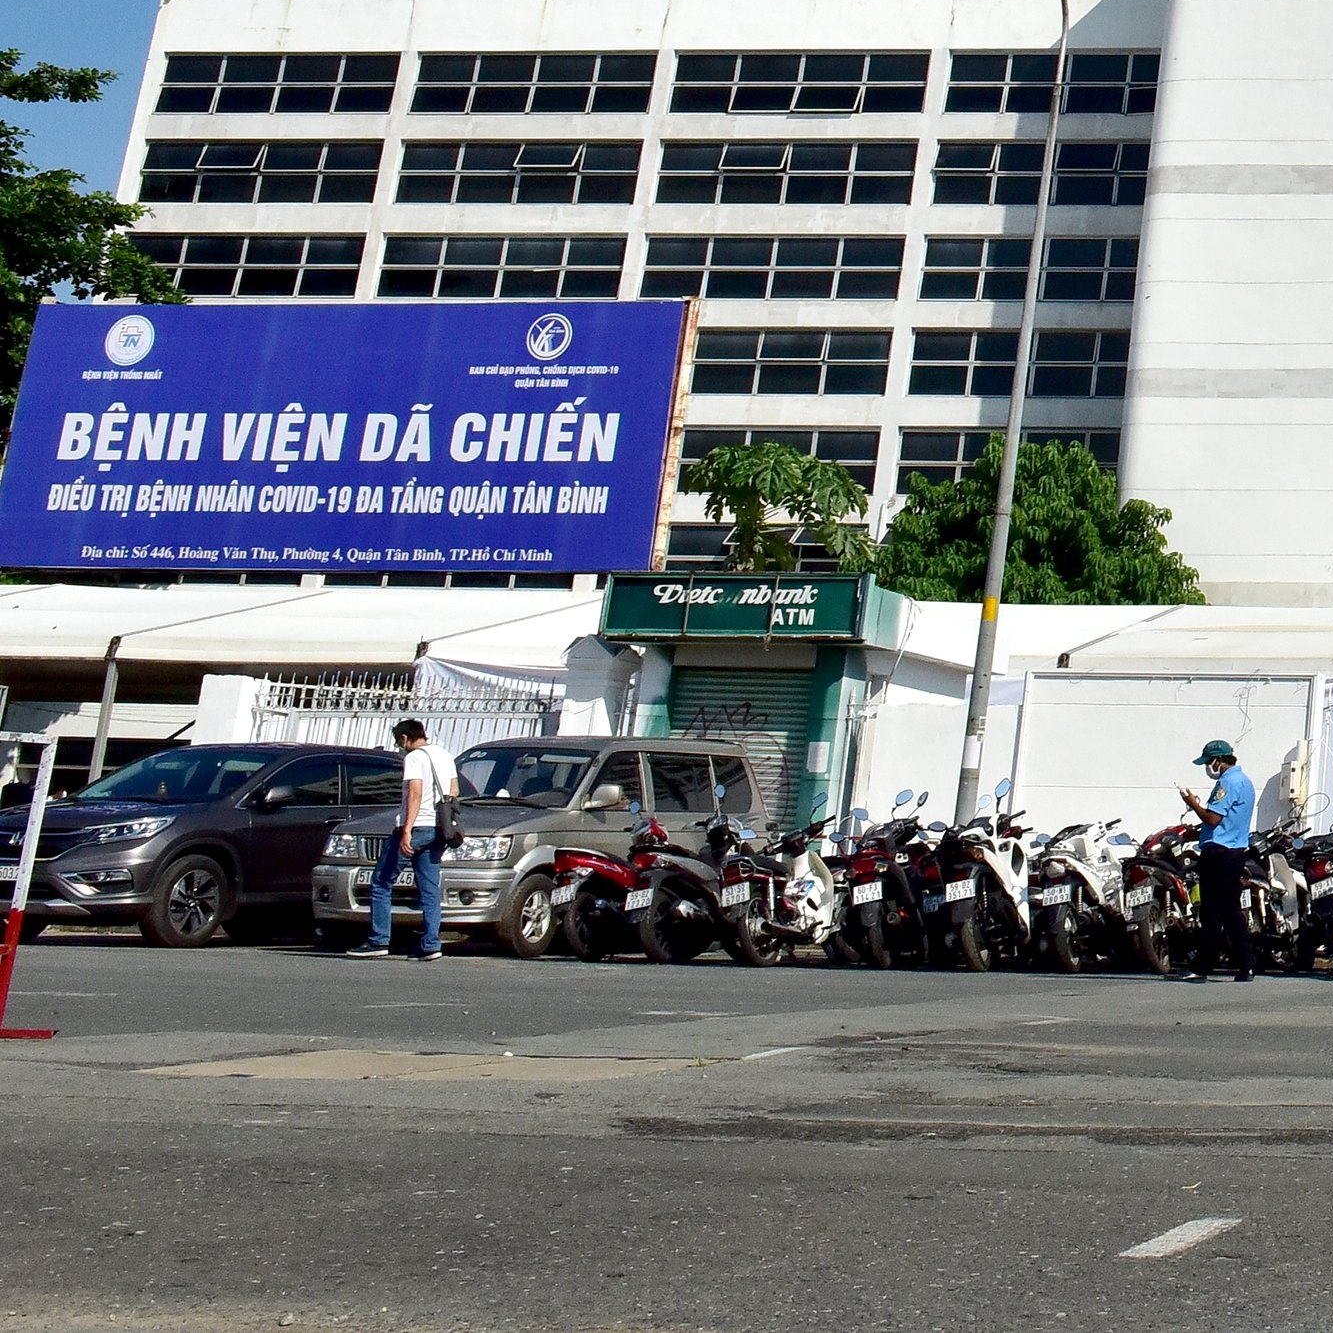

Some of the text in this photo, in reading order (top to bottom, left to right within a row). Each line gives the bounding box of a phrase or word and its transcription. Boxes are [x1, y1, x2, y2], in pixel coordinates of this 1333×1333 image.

[82, 370, 102, 382] BỆNH
[102, 370, 119, 382] VIỆN
[469, 366, 485, 375] BAN
[586, 365, 619, 375] COVID-19
[536, 378, 550, 388] TÂN
[56, 396, 621, 473] BỆNH VIỆN DÃ CHIẾN
[47, 475, 609, 520] ĐIỀU TRỊ BỆNH NHÂN COVID-19 ĐA TẦNG QUẬN TÂN BÌNH
[81, 545, 103, 561] Địa
[131, 544, 150, 559] Số
[150, 546, 175, 561] 446,
[178, 546, 219, 562] Hoàng
[223, 546, 247, 560] Văn
[251, 547, 279, 563] Thụ,
[282, 547, 329, 563] Phường
[331, 549, 344, 562] 4,
[347, 548, 381, 564] Quận
[385, 548, 409, 562] Tân
[412, 548, 445, 563] Bình,
[450, 547, 490, 562] TP.Hồ
[493, 547, 516, 562] Chí
[519, 548, 553, 562] Minh
[771, 608, 815, 626] ATM
